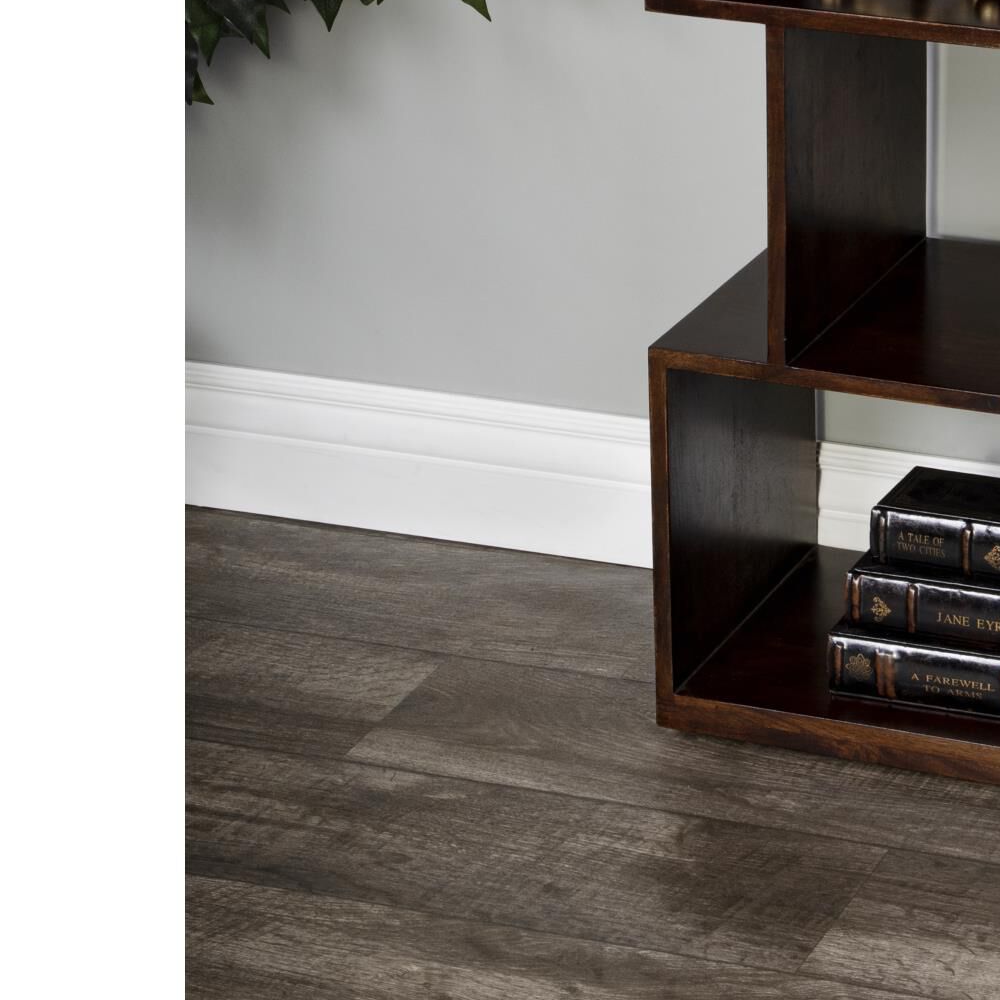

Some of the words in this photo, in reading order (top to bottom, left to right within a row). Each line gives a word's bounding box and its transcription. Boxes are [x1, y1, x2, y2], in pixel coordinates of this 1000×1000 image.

[897, 529, 905, 542] A
[907, 532, 930, 545] TALE
[932, 535, 945, 548] OF
[936, 611, 970, 627] JANE
[911, 672, 919, 681] A
[926, 674, 996, 693] FAREWELL
[923, 684, 940, 694] TO
[947, 688, 984, 700] ARMS
